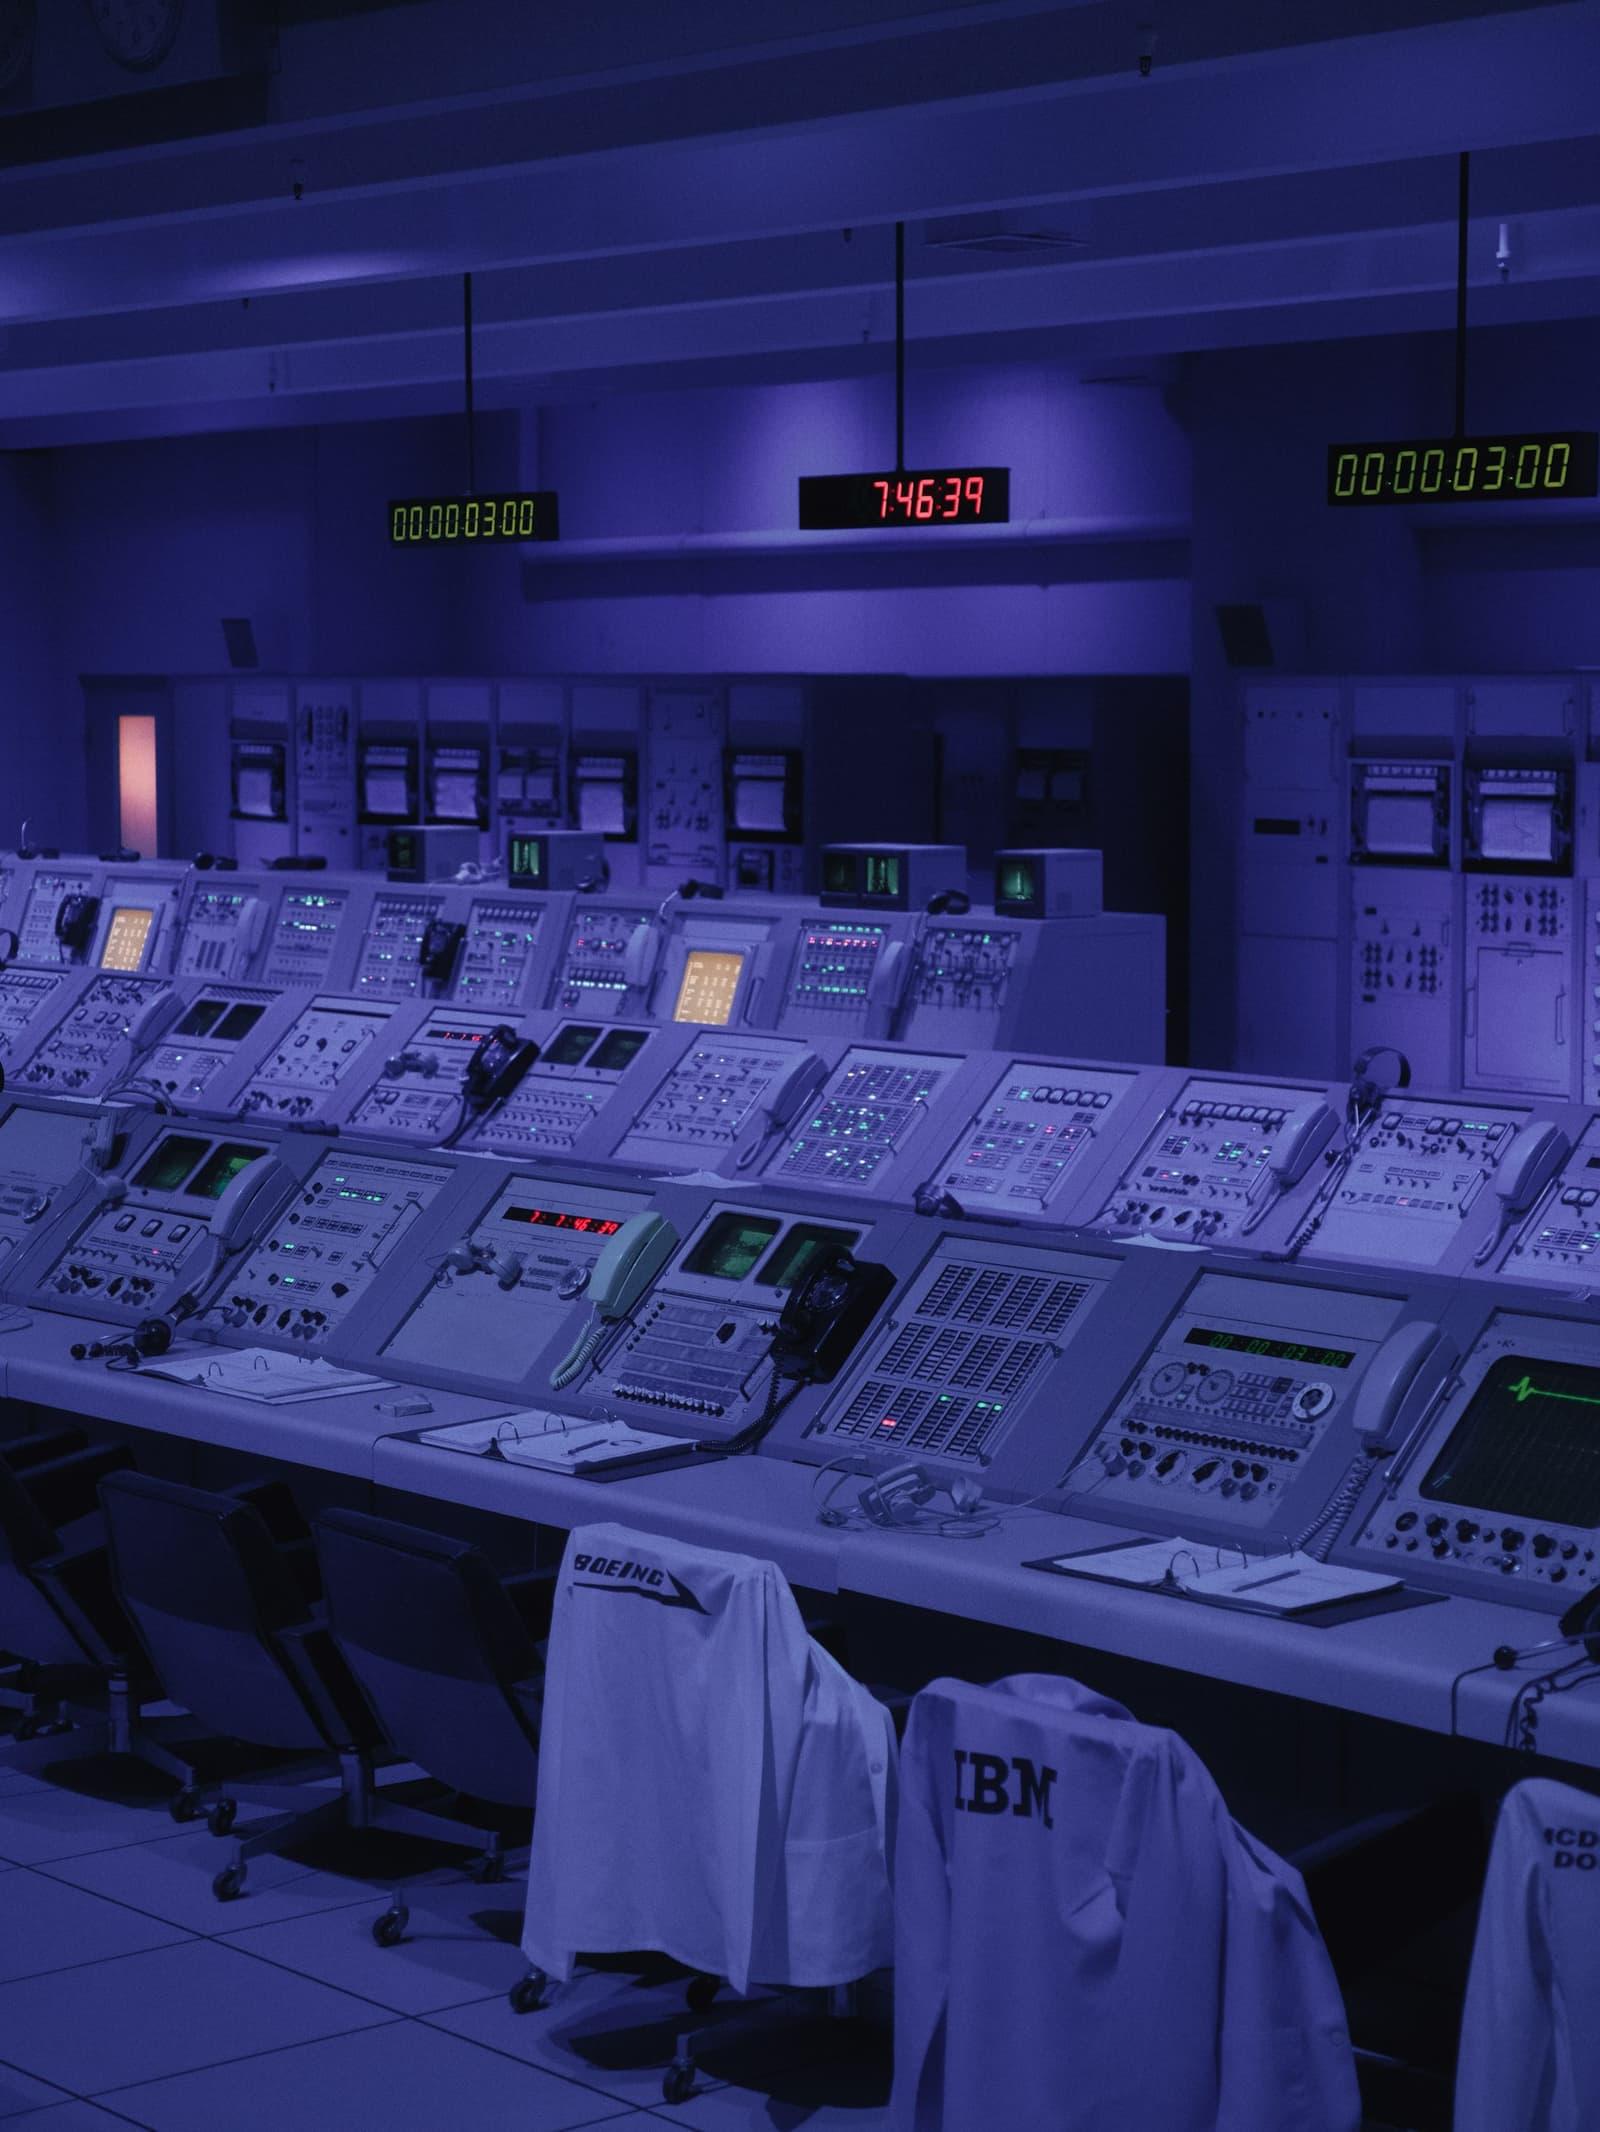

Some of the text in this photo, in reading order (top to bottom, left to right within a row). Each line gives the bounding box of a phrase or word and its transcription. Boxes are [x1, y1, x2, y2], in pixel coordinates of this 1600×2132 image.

[873, 477, 984, 518] 7:46:39
[574, 1554, 664, 1586] BOEING
[954, 1750, 1058, 1830] IBM
